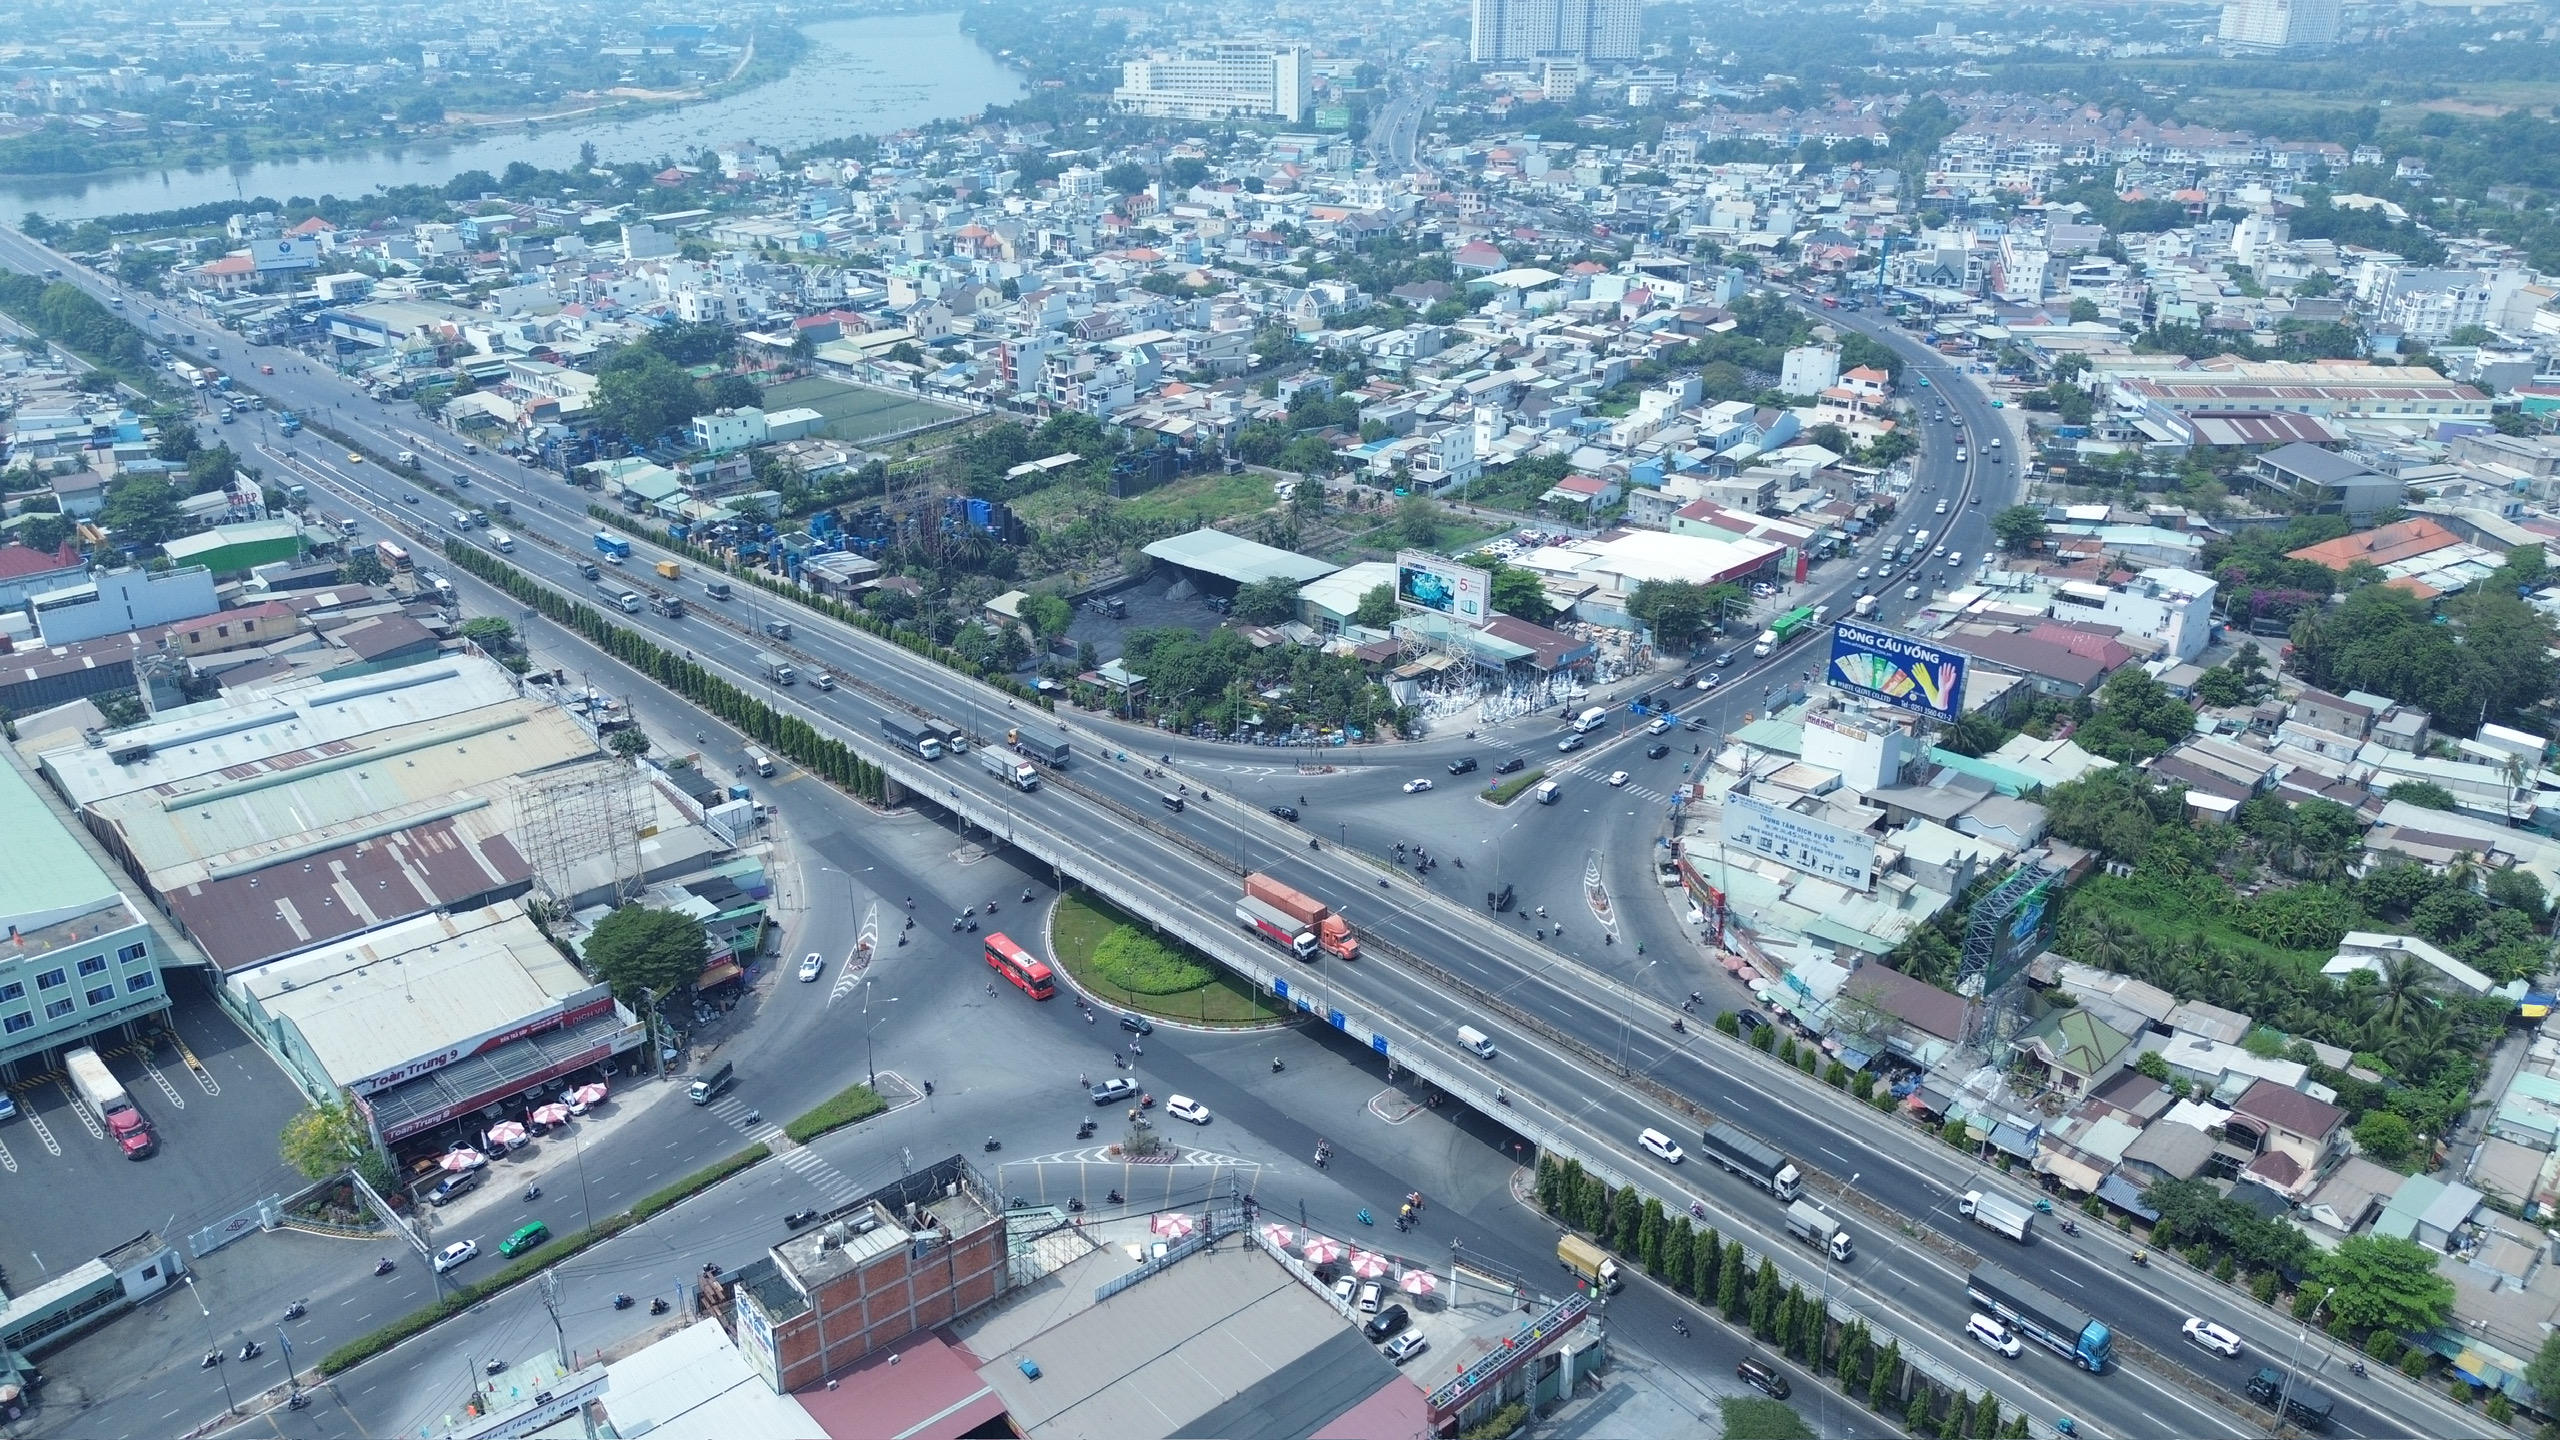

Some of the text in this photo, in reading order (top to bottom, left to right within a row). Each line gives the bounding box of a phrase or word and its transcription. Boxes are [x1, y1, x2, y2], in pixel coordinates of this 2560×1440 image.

[1459, 578, 1468, 591] 5
[1837, 681, 1854, 692] WHITE
[1854, 686, 1871, 697] GLOVE
[1760, 815, 1780, 826] TRUNG
[1782, 820, 1796, 831] TÂM
[1824, 833, 1835, 843] 4S
[370, 1071, 405, 1089] Toàn
[407, 1053, 447, 1075] Trung
[450, 1049, 458, 1060] 9
[414, 1116, 442, 1129] Trung
[442, 1110, 450, 1119] 9
